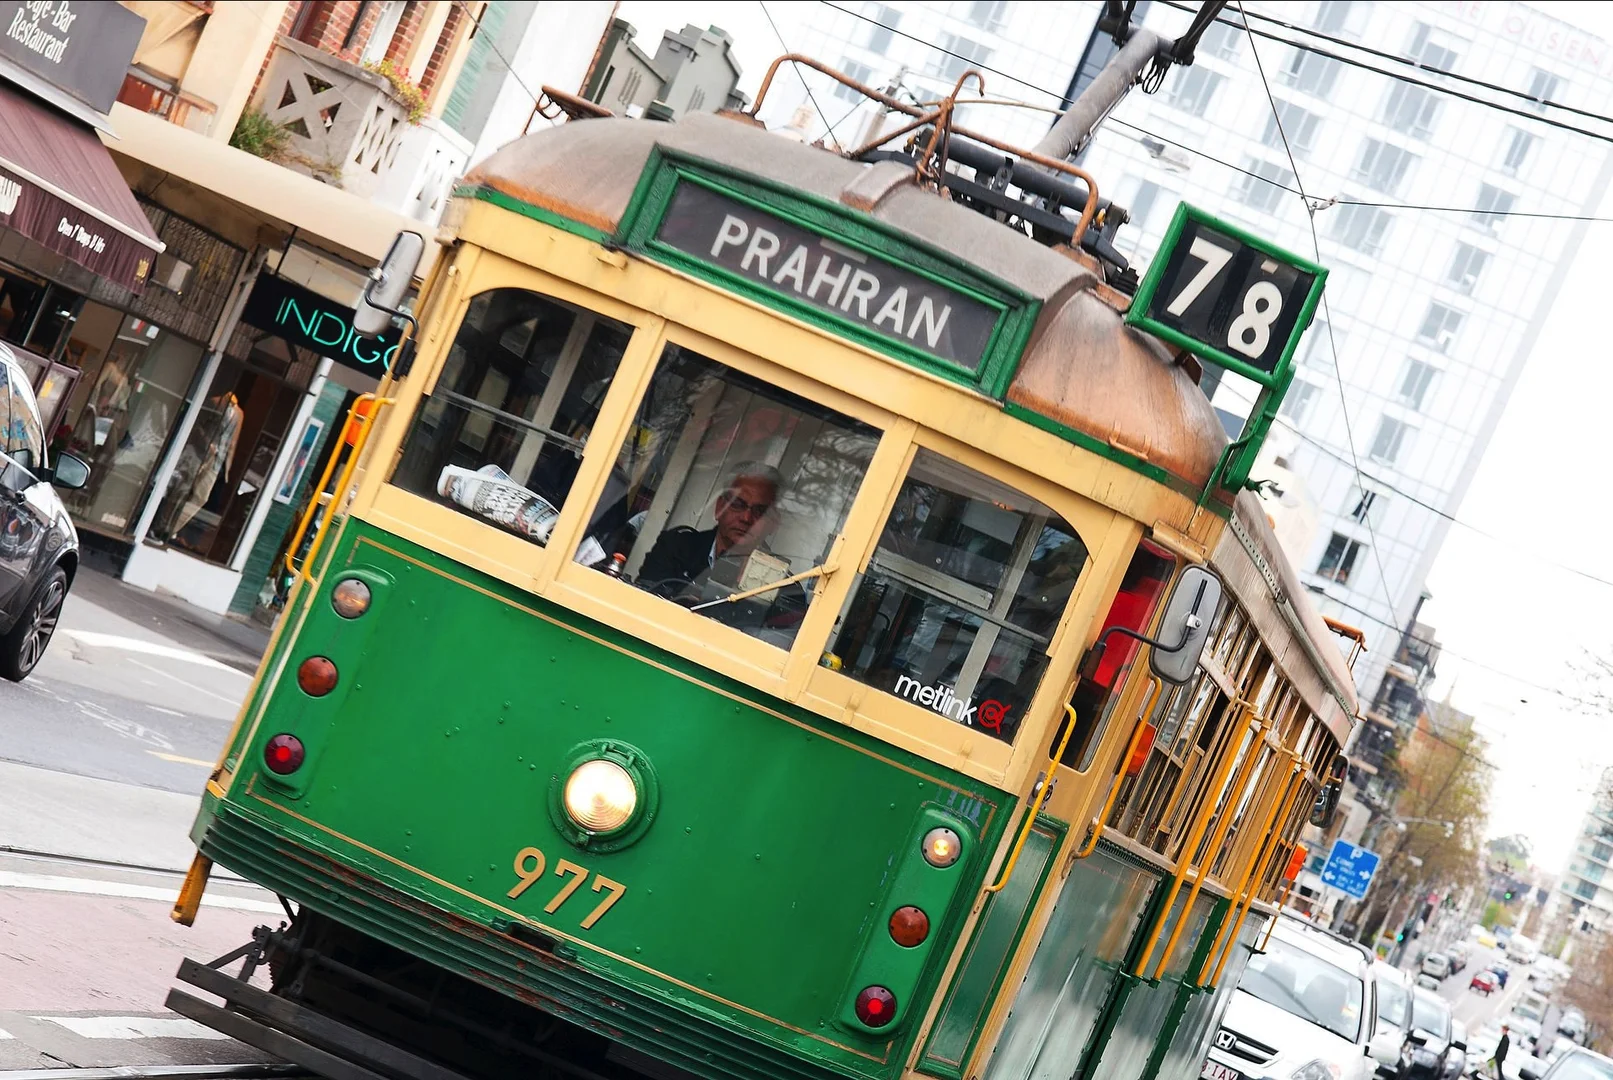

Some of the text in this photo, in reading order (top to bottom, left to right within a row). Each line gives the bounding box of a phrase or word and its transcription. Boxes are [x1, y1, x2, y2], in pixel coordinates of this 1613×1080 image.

[6, 8, 70, 64] Restaurant
[710, 214, 951, 348] PRAHRAN
[894, 674, 977, 725] metlink
[506, 847, 626, 930] 977
